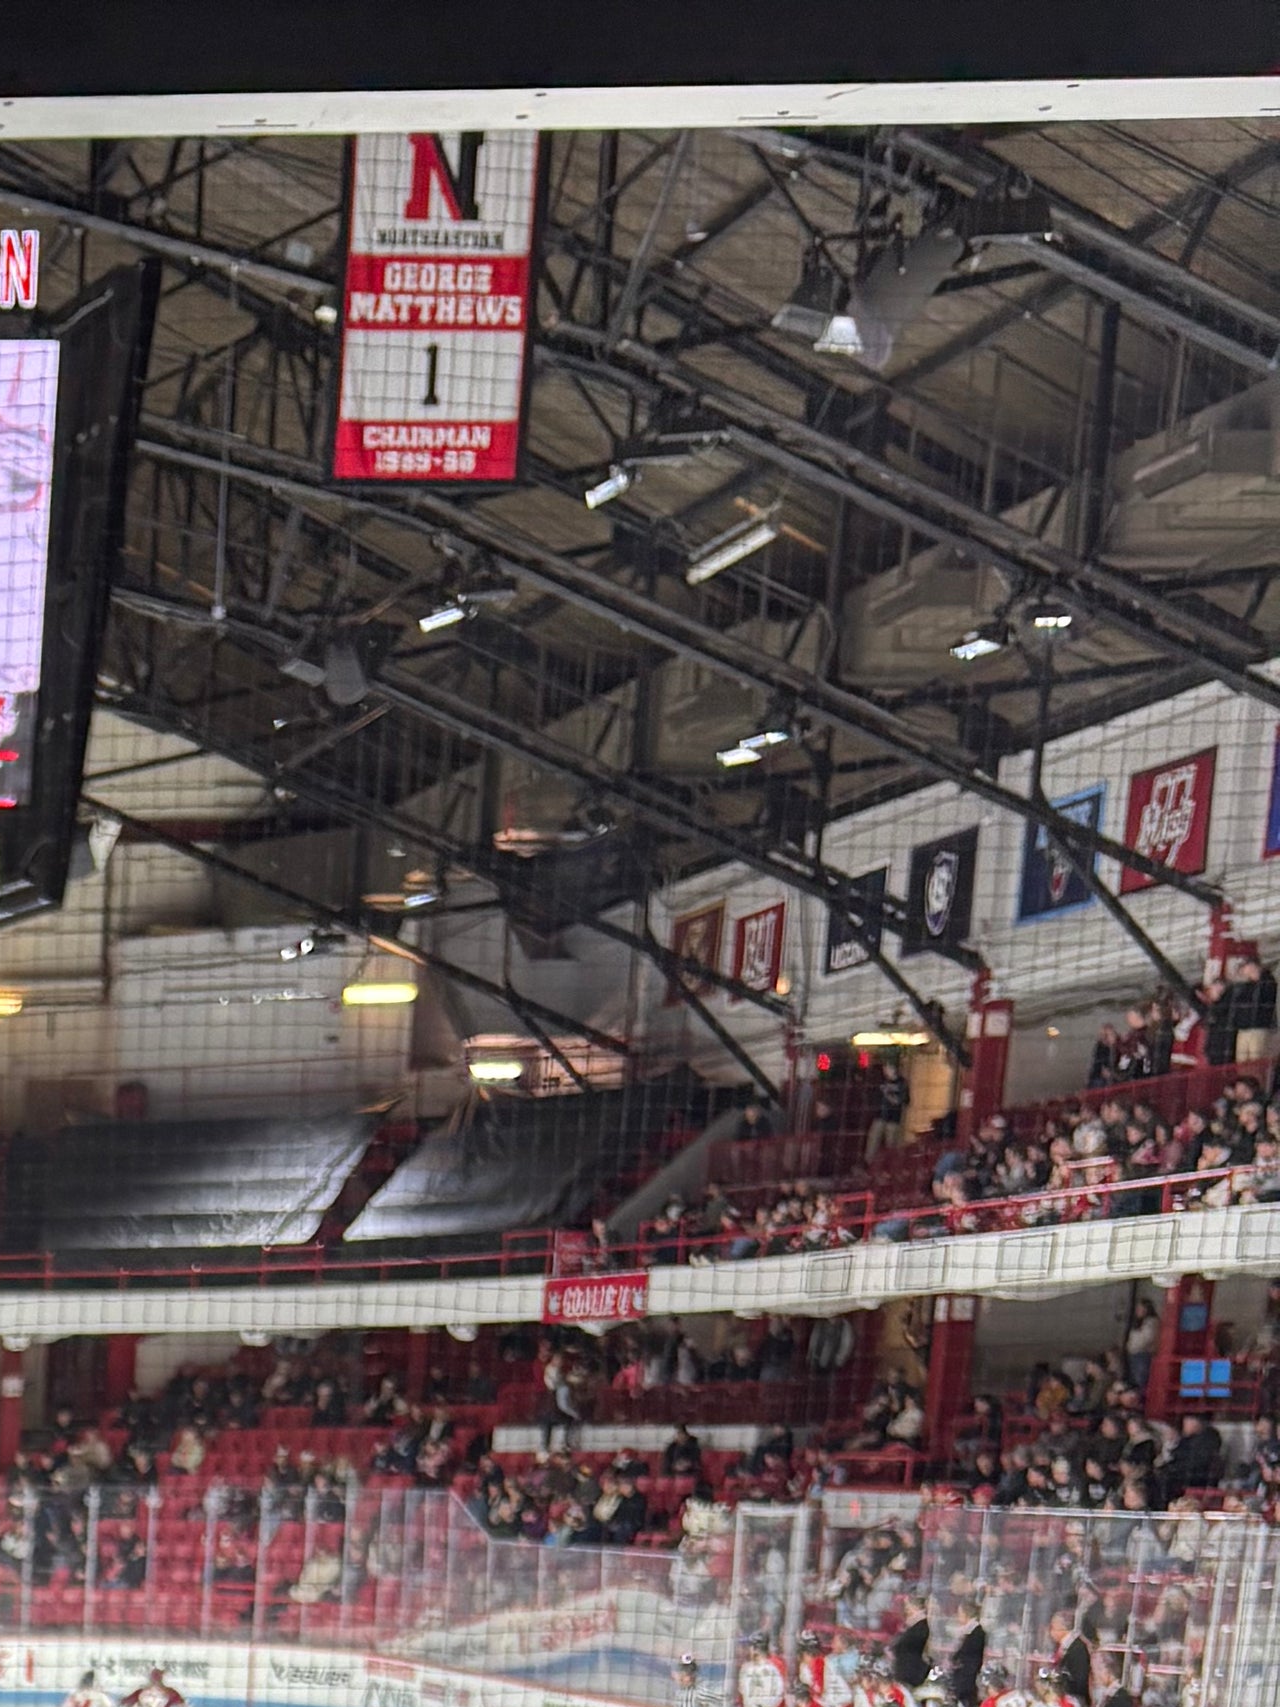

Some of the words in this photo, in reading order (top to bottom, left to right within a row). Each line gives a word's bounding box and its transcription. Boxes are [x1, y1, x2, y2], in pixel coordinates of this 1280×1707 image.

[384, 261, 493, 294] GEORGE
[350, 291, 522, 326] MATTHEWS
[423, 342, 439, 406] 1
[363, 425, 491, 450] CHAIRMAN
